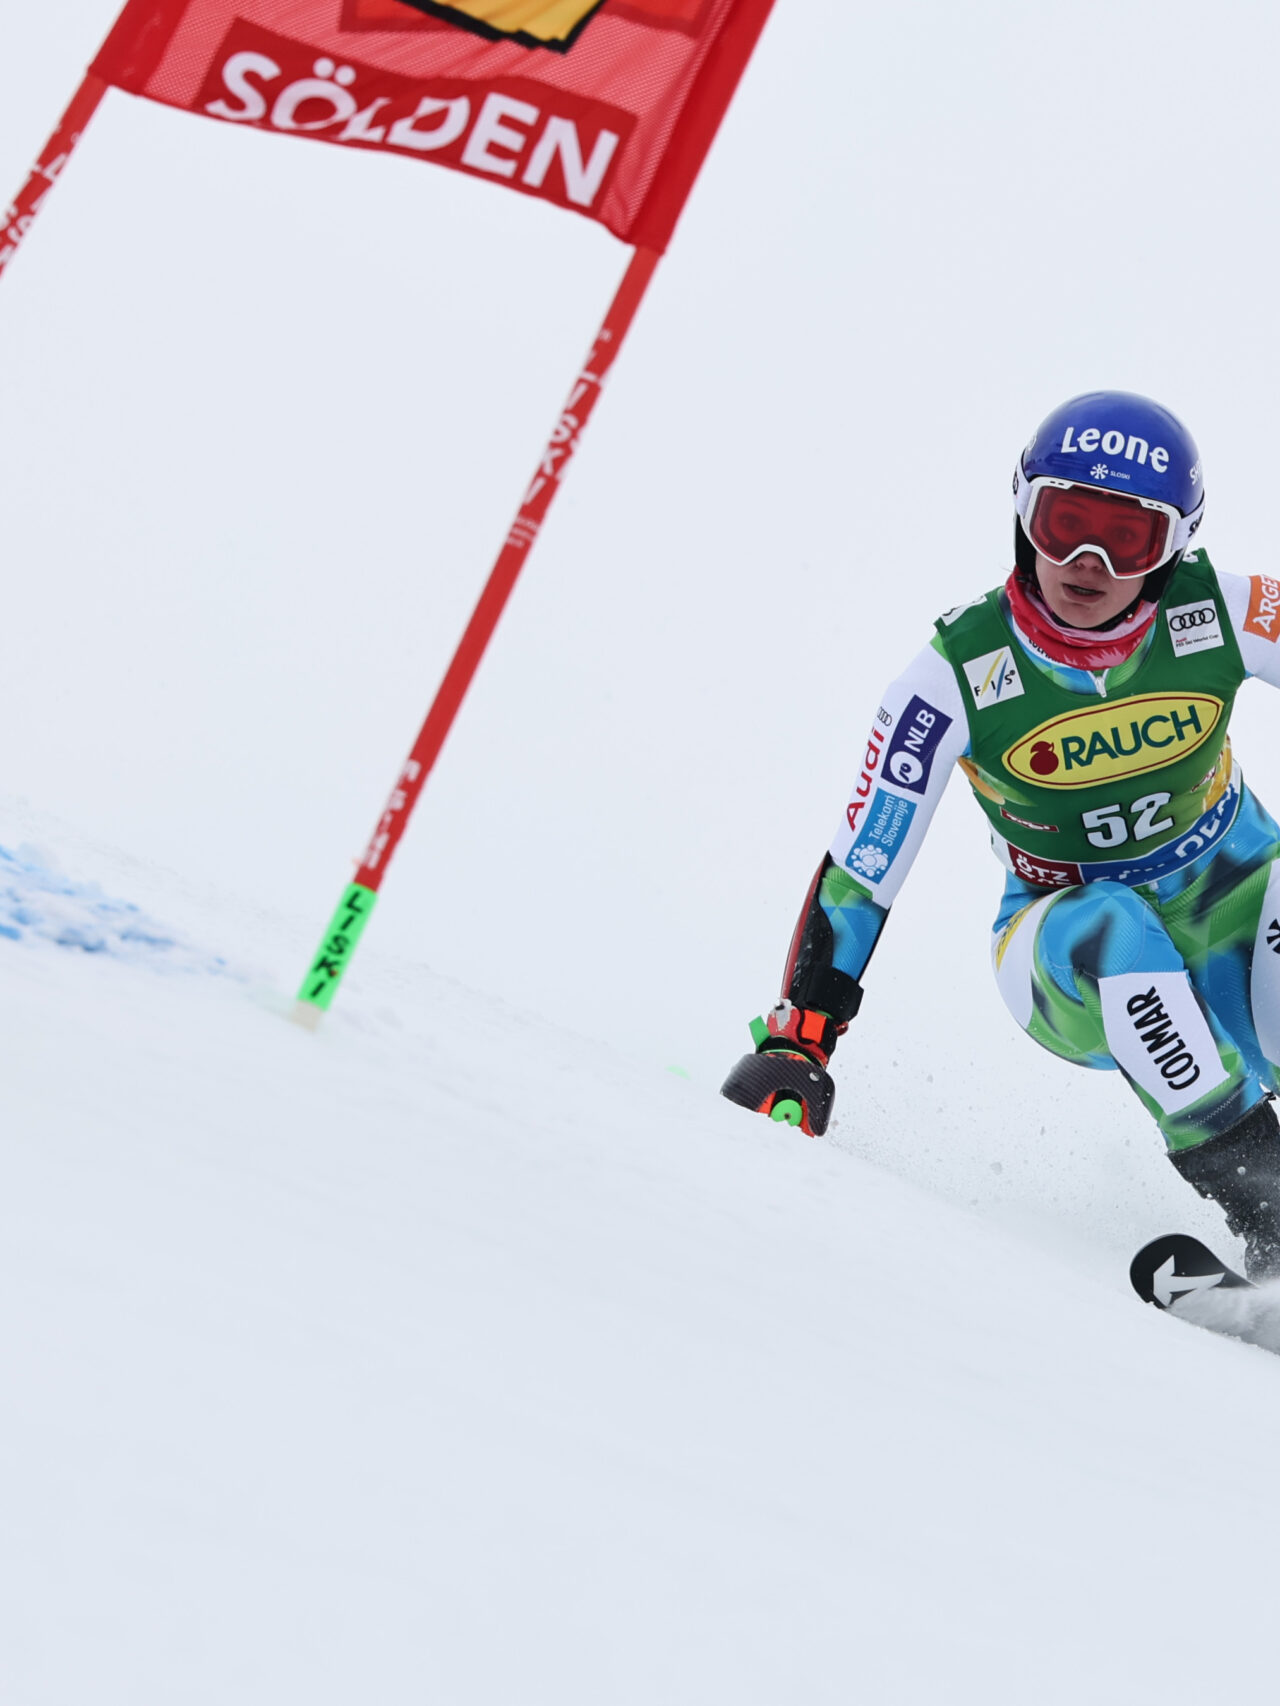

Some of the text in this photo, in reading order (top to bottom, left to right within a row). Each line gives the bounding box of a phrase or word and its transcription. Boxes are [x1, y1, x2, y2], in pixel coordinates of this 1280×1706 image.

[205, 51, 620, 207] SÖLDEN
[1060, 427, 1170, 473] Leone
[903, 709, 936, 753] NLB
[1060, 705, 1203, 771] RAUCH
[846, 725, 885, 832] Audi
[868, 794, 896, 841] Telekom
[881, 800, 909, 847] Slovenije
[1082, 792, 1174, 848] 52
[1016, 853, 1070, 882] ÖTZ
[310, 891, 363, 998] LISKI
[1126, 986, 1200, 1090] COLMAR
